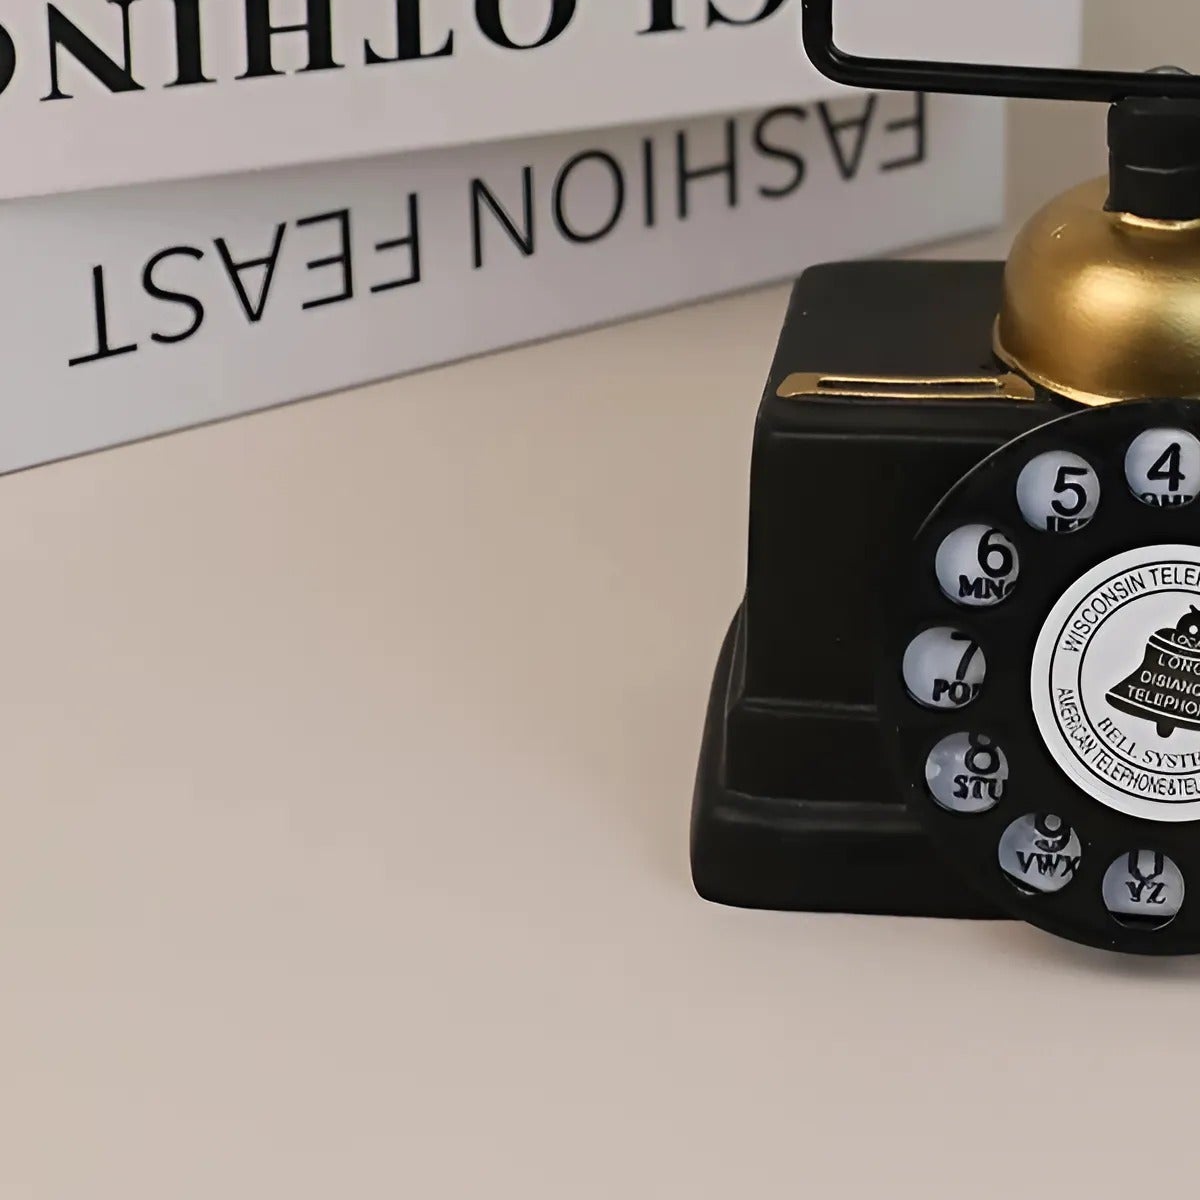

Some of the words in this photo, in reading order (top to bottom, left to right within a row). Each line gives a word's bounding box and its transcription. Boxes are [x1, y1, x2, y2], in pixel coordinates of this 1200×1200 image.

[470, 92, 926, 268] FASHION
[69, 191, 422, 367] FEAST
[1051, 466, 1089, 517] 5
[1147, 442, 1186, 491] 4
[978, 528, 1013, 578] 6
[1062, 571, 1146, 653] WISCONSIN
[951, 631, 980, 680] 7
[964, 731, 1000, 775] 8
